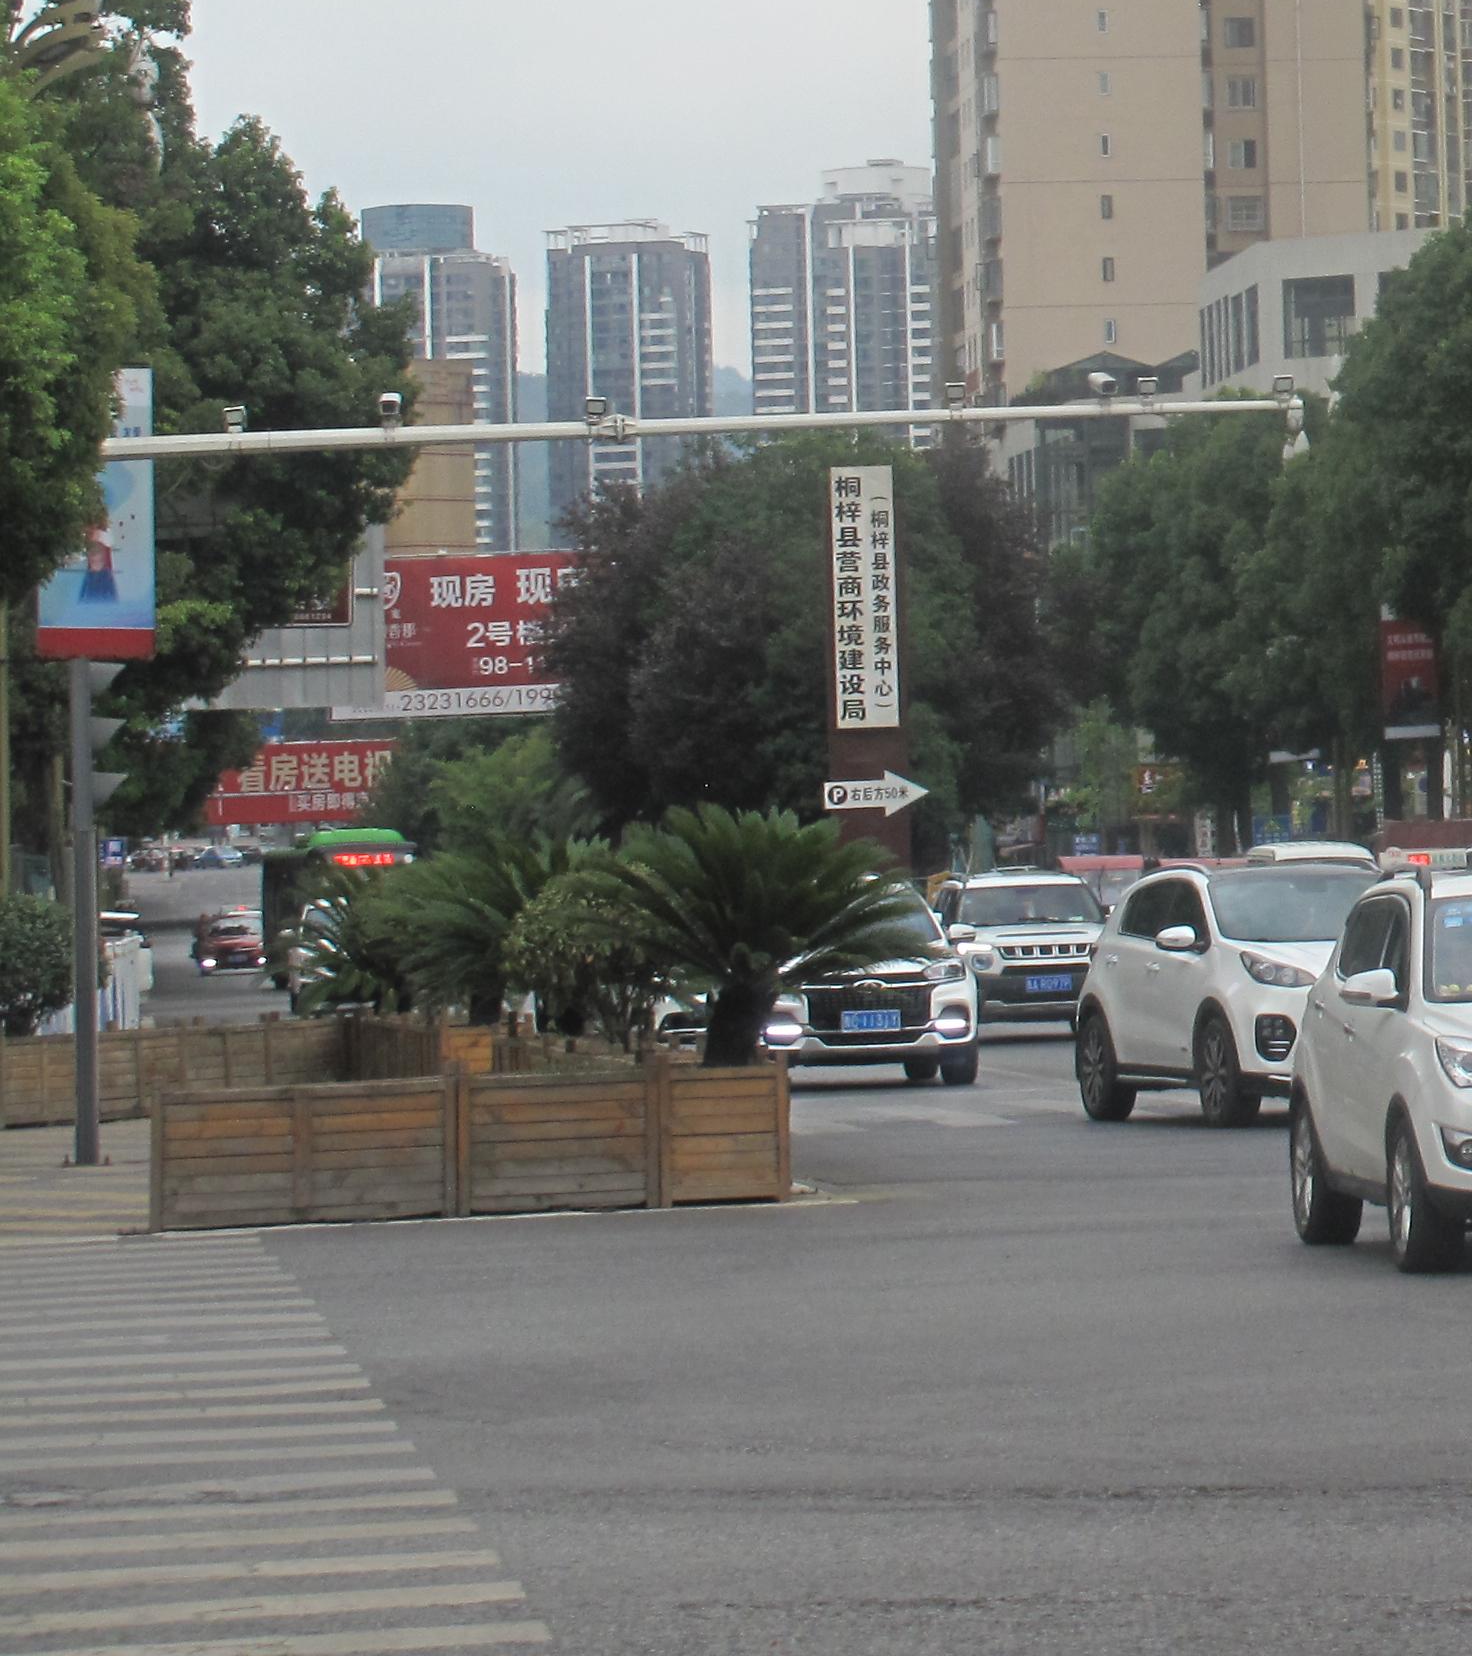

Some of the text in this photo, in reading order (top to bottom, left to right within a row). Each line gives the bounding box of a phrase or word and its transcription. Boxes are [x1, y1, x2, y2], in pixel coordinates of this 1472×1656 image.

[430, 574, 496, 608] 现房
[834, 475, 866, 722] 桐梓县营商环境建设局
